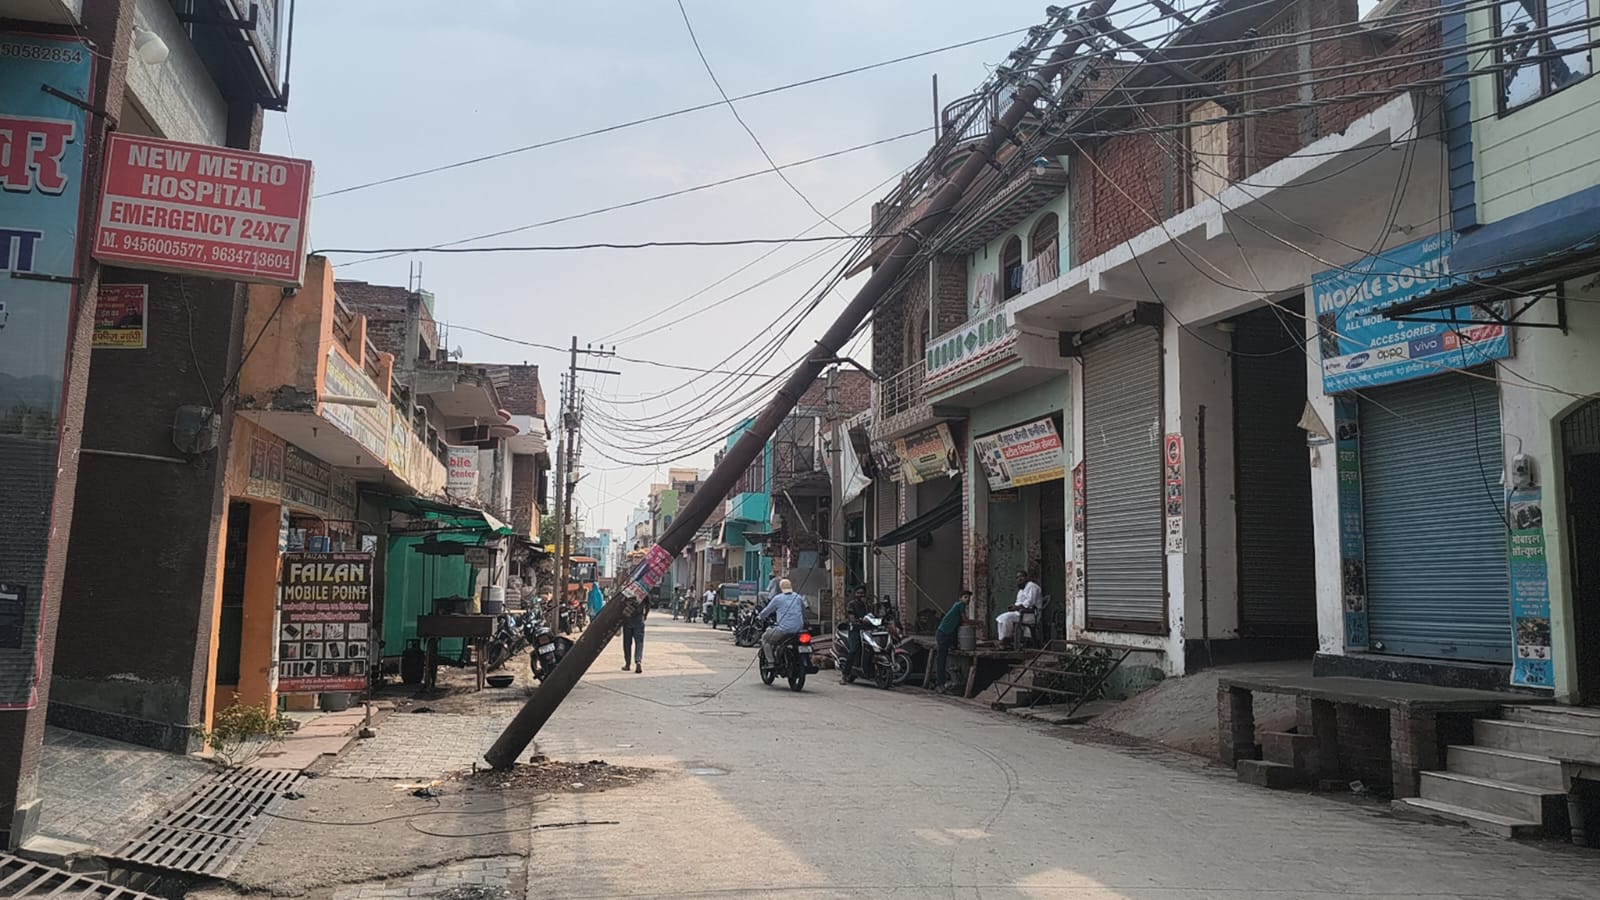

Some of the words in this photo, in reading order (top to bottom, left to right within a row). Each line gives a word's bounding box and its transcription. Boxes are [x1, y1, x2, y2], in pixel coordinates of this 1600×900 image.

[127, 144, 191, 172] NEW
[198, 154, 287, 186] METRO
[141, 174, 266, 211] HOSPITAL
[109, 201, 236, 237] EMERGENCY
[240, 218, 291, 243] 24X7
[102, 231, 118, 249] M.
[123, 235, 207, 262] 9456005577,
[211, 246, 290, 269] 9634713604
[1319, 278, 1382, 312] MOBILE
[1345, 321, 1360, 332] ALL
[1370, 323, 1437, 348] ACCESSORIES
[1414, 340, 1438, 351] vivo
[450, 470, 476, 478] Center
[290, 563, 364, 584] FAIZAN
[285, 585, 329, 600] MOBILE
[332, 585, 367, 600] POINT
